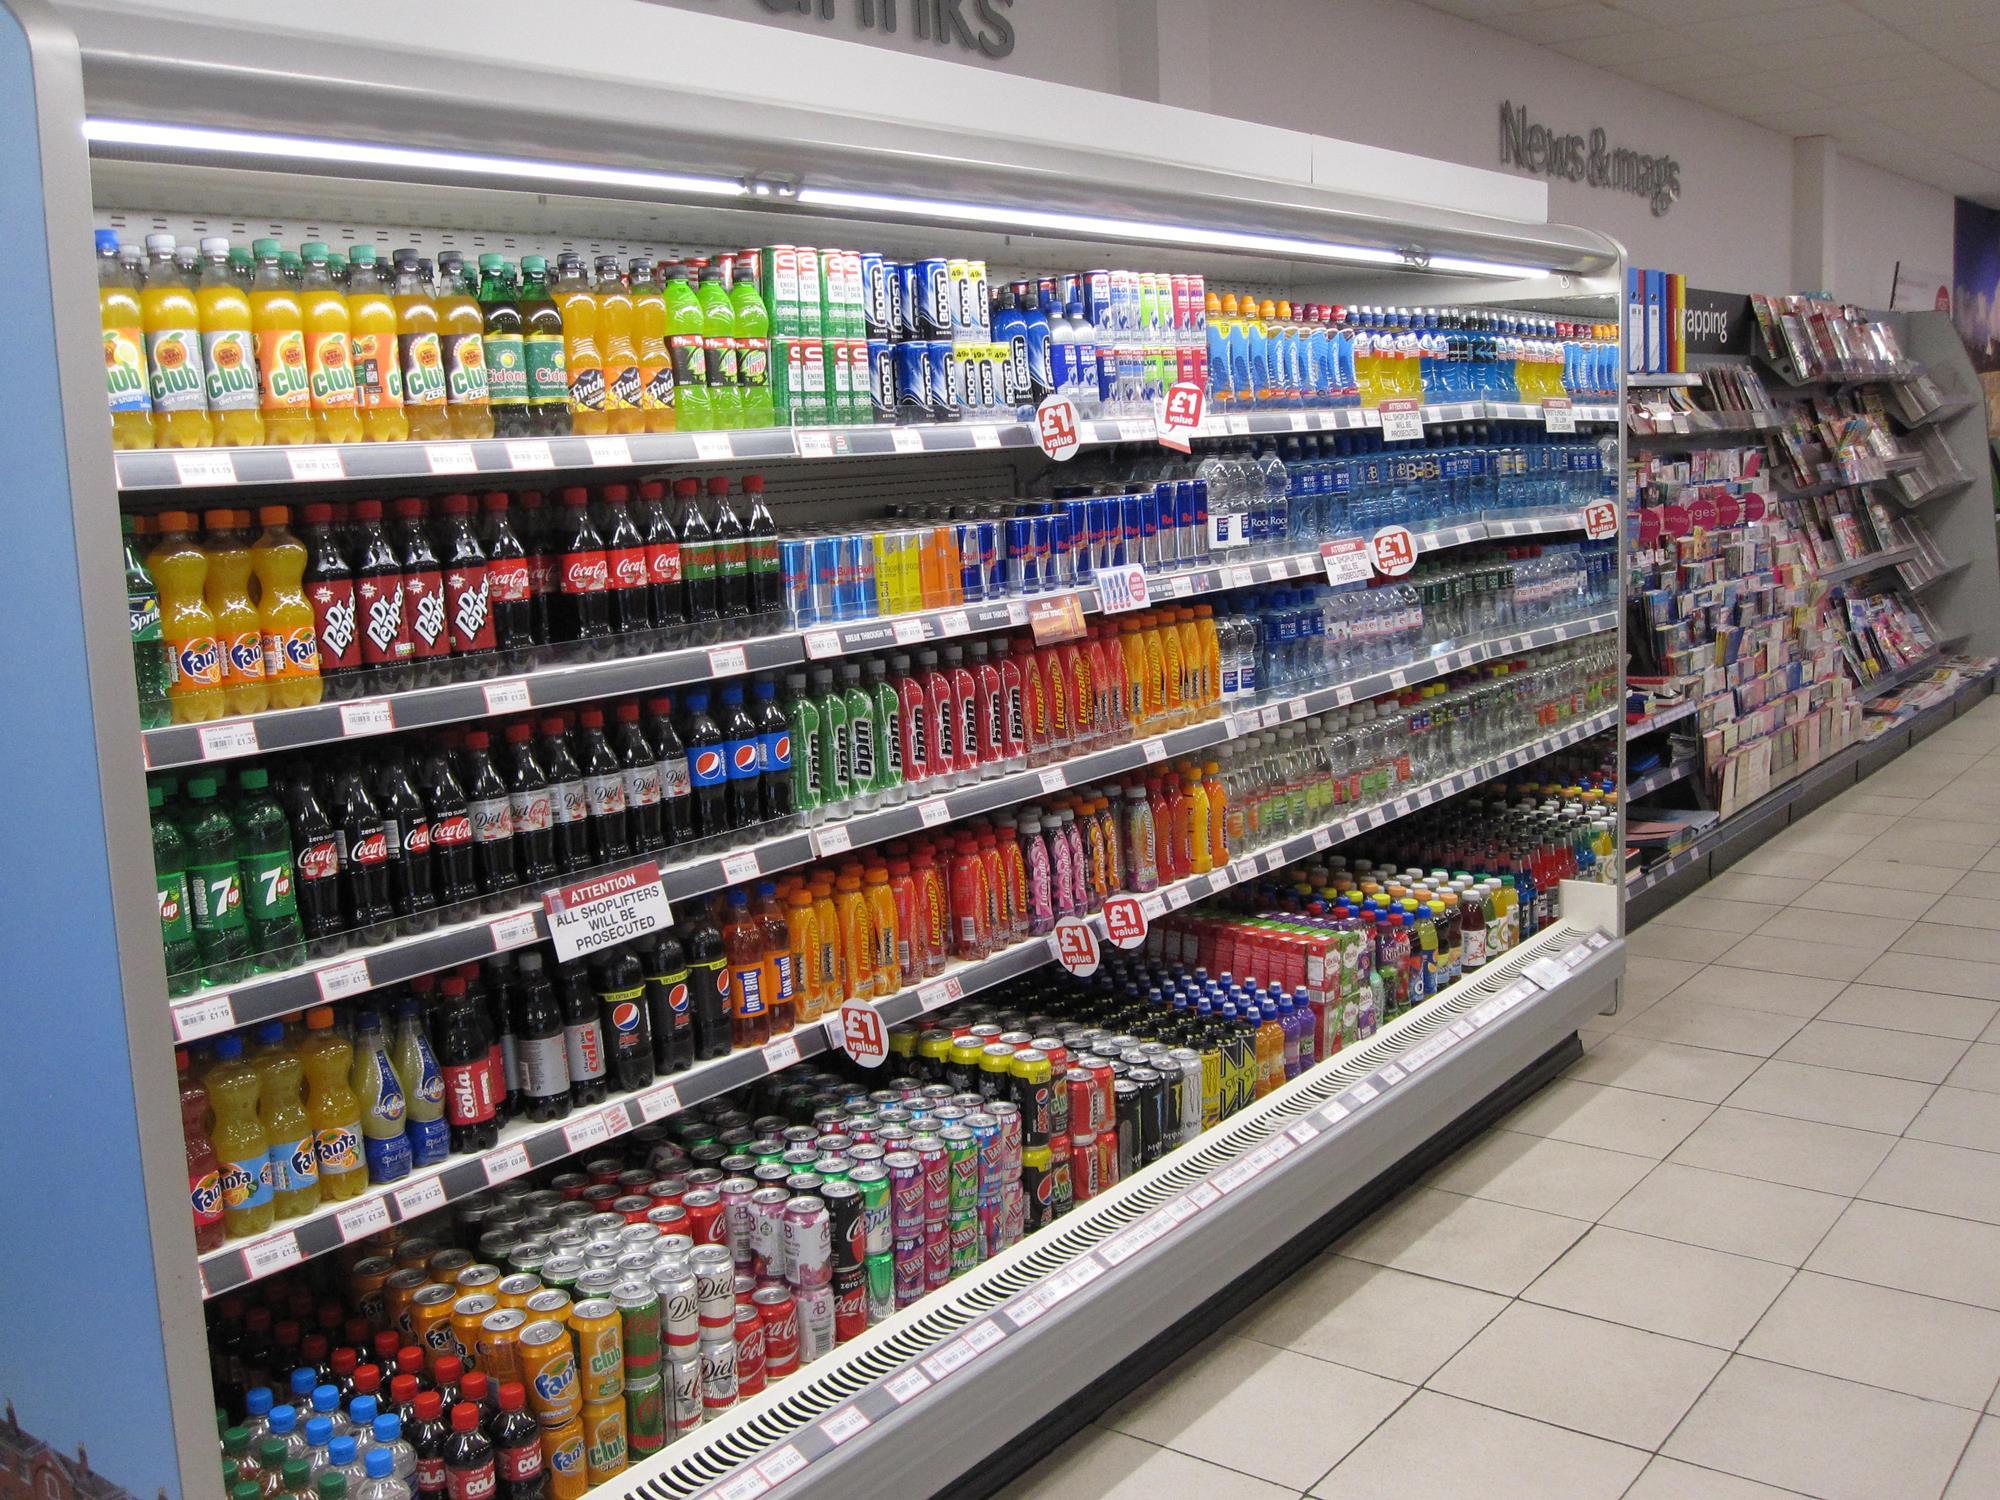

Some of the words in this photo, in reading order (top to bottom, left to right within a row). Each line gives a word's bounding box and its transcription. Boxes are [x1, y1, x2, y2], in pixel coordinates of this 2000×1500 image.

[1501, 100, 1586, 183] News
[1613, 147, 1681, 217] mags
[876, 270, 886, 320] BOOST
[938, 272, 949, 323] BOOST
[961, 282, 971, 324] BOOST
[1682, 304, 1728, 343] rapping
[151, 362, 200, 399] club
[207, 362, 254, 399] club
[884, 353, 893, 405] BOOST
[966, 363, 976, 405] BOOST
[982, 364, 992, 405] BOOST
[1004, 362, 1014, 404] BOOST
[1168, 391, 1198, 415] £1
[1041, 404, 1069, 436] £1
[1169, 414, 1195, 425] value
[1046, 434, 1074, 450] value
[1330, 543, 1357, 554] ATTENTION
[1378, 533, 1408, 559] £1
[1382, 554, 1410, 567] value
[1337, 568, 1368, 582] PROSECUTED
[325, 600, 346, 628] Dr
[369, 595, 391, 625] Dr
[417, 590, 437, 618] Dr
[455, 573, 490, 641] Pepper
[458, 585, 478, 612] Dr
[366, 582, 405, 652] Pepper
[1152, 640, 1163, 706] Lucozade
[1170, 637, 1182, 702] Lucozade
[1055, 665, 1066, 730] Lucozade
[942, 702, 953, 755] bpm
[965, 699, 977, 753] bpm
[1011, 688, 1023, 739] bpm
[853, 719, 873, 777] bpm
[914, 708, 926, 762] bpm
[571, 873, 637, 904] ATTENTION
[1016, 857, 1027, 913] Lucozade
[556, 912, 579, 928] ALL
[580, 885, 660, 920] SHOPLIFTERS
[588, 916, 618, 932] WILL
[621, 907, 637, 922] BE
[929, 885, 940, 946] Lucozade
[1110, 902, 1137, 927] £1
[576, 916, 656, 951] PROSECUTED
[1061, 927, 1088, 952] £1
[1113, 926, 1140, 937] value
[1065, 952, 1092, 964] value
[209, 1009, 231, 1021] £1.19
[845, 1010, 877, 1041] £1
[582, 1029, 599, 1073] cola
[849, 1040, 879, 1054] value
[455, 1071, 476, 1119] cola
[314, 1134, 357, 1164] Fanta
[425, 1188, 441, 1200] £1.25
[368, 1210, 386, 1222] £1.35
[698, 1275, 733, 1302] Diet
[591, 1348, 621, 1373] club
[701, 1355, 734, 1382] Diet
[675, 1380, 692, 1397] iet
[589, 1436, 625, 1466] club
[418, 1470, 446, 1484] OLA
